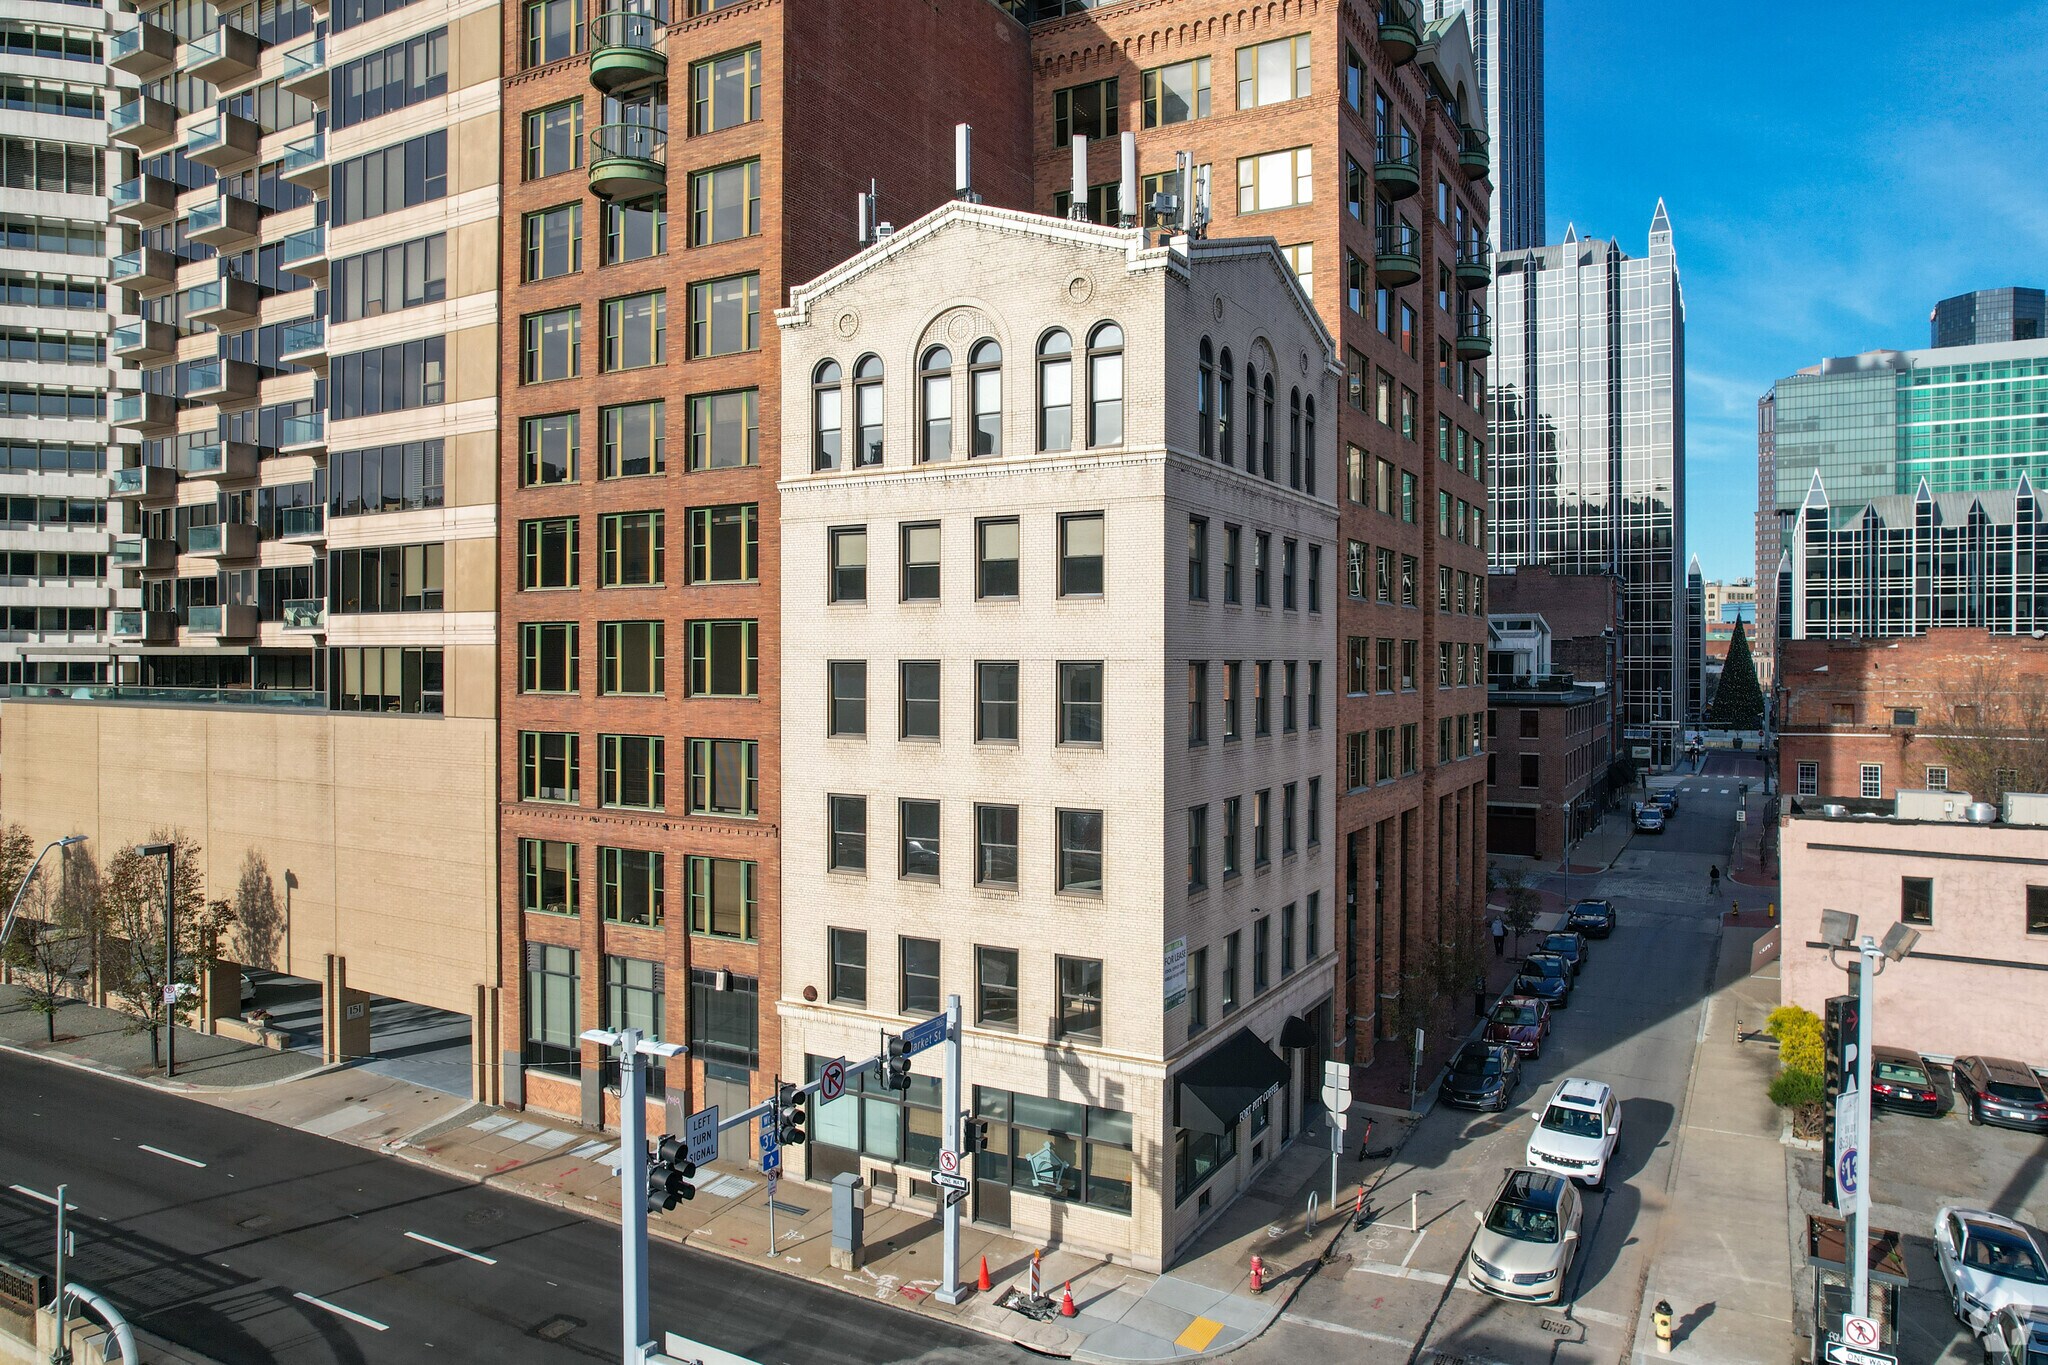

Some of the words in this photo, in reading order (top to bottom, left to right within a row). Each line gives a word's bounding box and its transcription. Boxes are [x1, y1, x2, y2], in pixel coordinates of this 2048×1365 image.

[1164, 955, 1174, 966] FOR
[1175, 949, 1186, 962] LEASE
[349, 1004, 361, 1015] 151
[934, 1030, 942, 1042] St
[1239, 1104, 1252, 1122] FORT
[1252, 1094, 1263, 1111] PITT
[1262, 1080, 1279, 1102] COFFEE
[693, 1114, 711, 1131] LEFT
[692, 1129, 712, 1147] TURN
[762, 1132, 776, 1150] 37
[689, 1144, 715, 1163] SIGNAL
[1847, 1352, 1866, 1364] ONE
